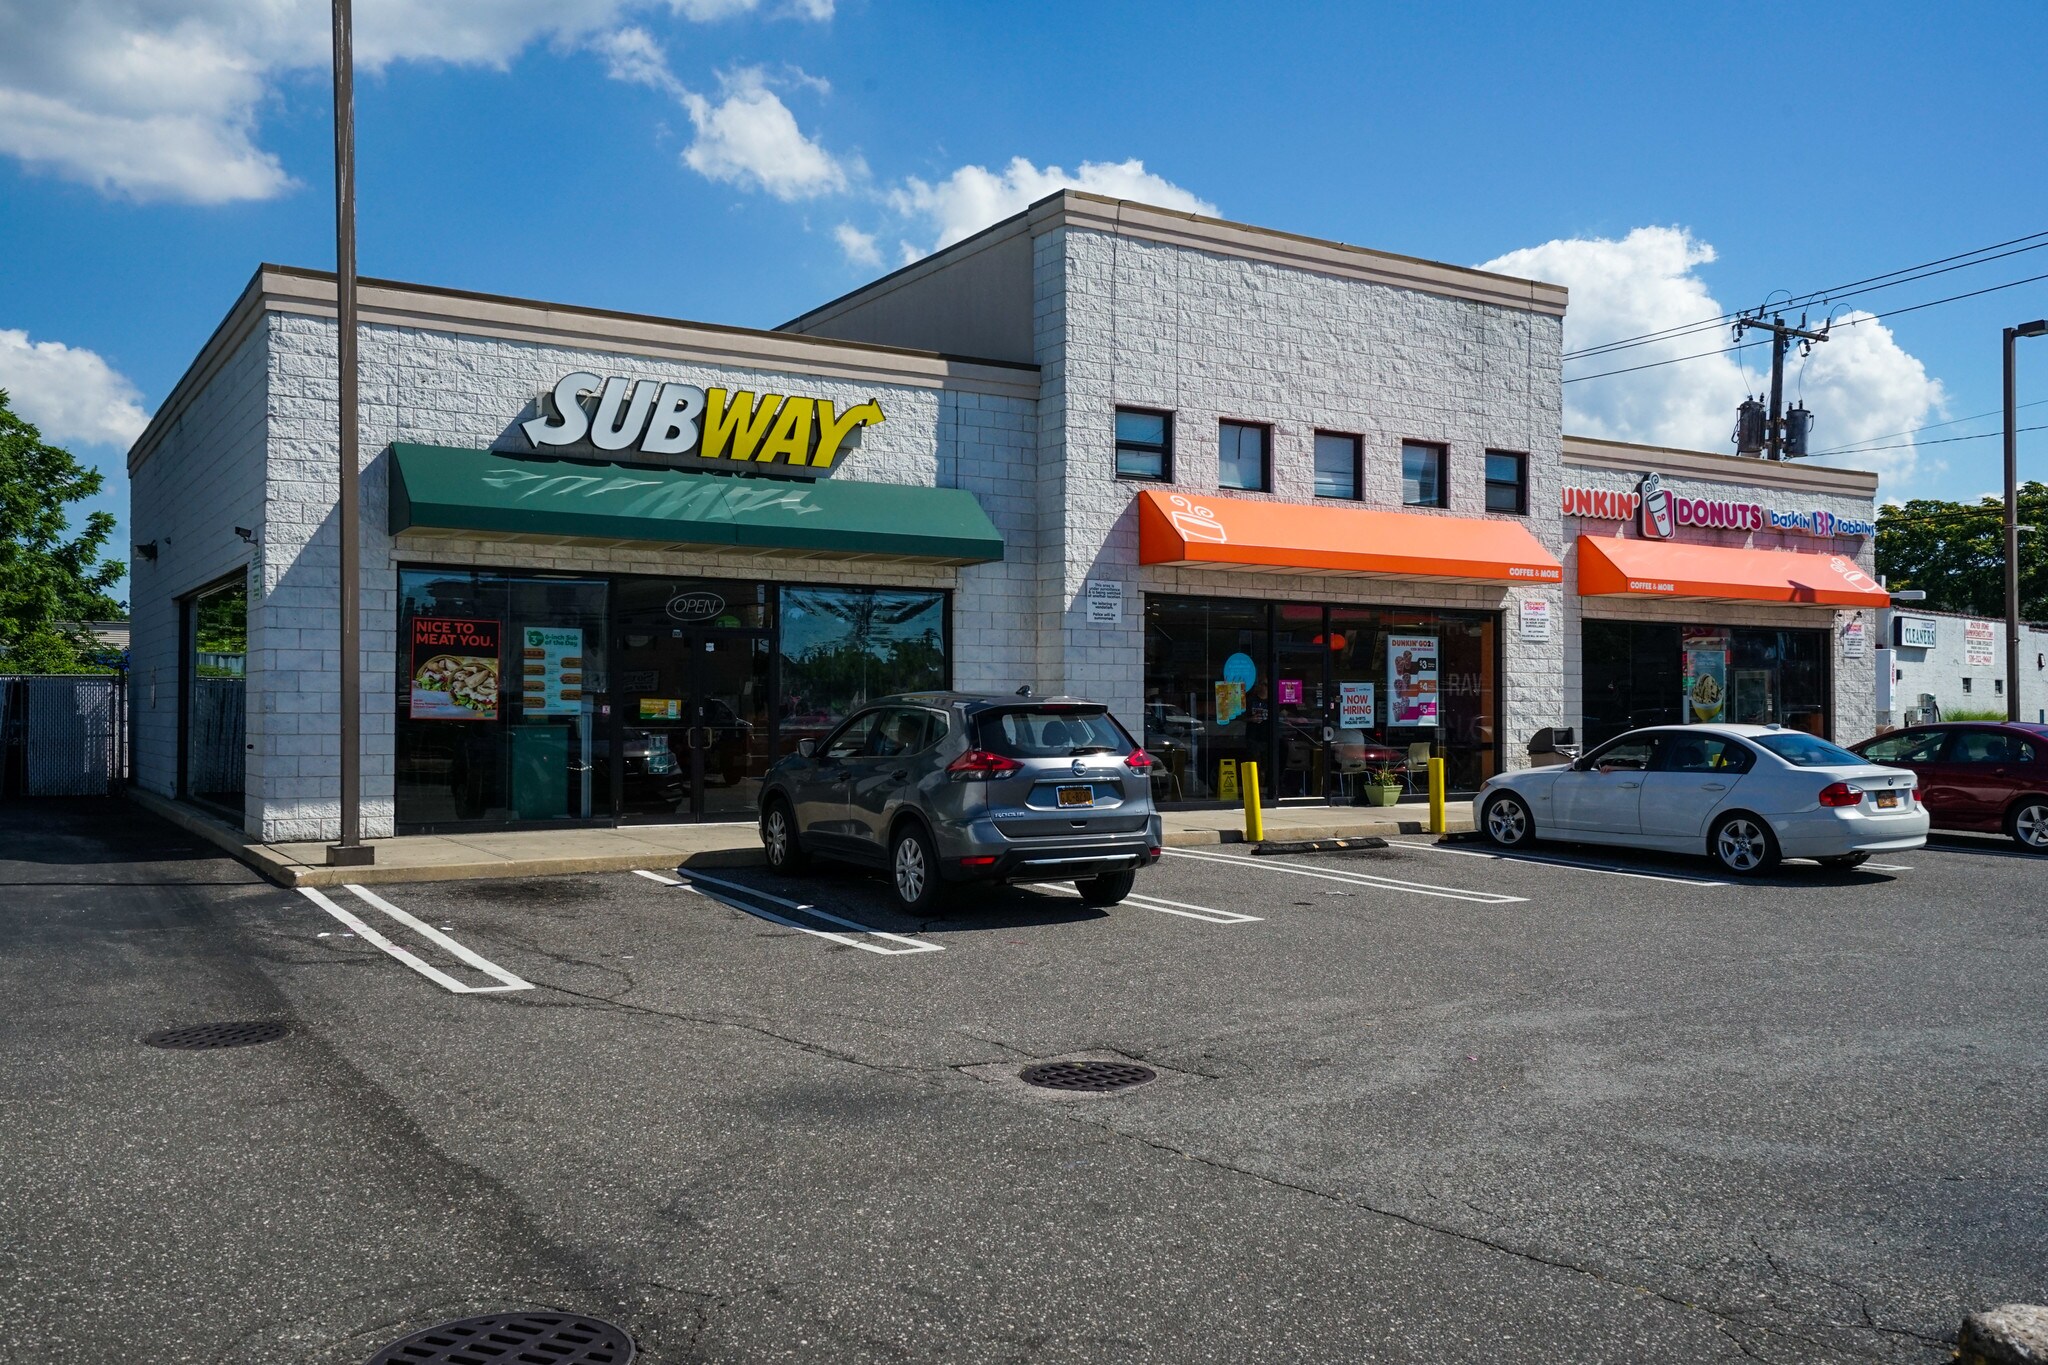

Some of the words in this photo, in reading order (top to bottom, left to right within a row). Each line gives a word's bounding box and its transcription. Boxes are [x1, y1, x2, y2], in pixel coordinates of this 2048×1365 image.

[519, 371, 887, 468] SUBWAY
[1562, 488, 1639, 519] UNKIN'
[1678, 499, 1761, 531] DONUTS
[1771, 510, 1810, 530] baskin
[1838, 519, 1875, 538] robbins
[1510, 568, 1534, 577] COFFEE
[1541, 570, 1559, 578] MORE
[1630, 582, 1652, 590] COFFEE
[1658, 583, 1674, 591] MORE
[674, 599, 717, 614] OPEN
[417, 622, 451, 633] NICE
[455, 623, 475, 634] TO
[416, 634, 457, 645] MEAT
[460, 635, 494, 647] YOU.
[1905, 628, 1934, 645] CLEANERS
[1420, 660, 1427, 669] $3
[1420, 682, 1428, 691] $4
[1347, 695, 1368, 704] NOW
[1343, 705, 1371, 714] HIRING
[1420, 705, 1428, 714] $5
